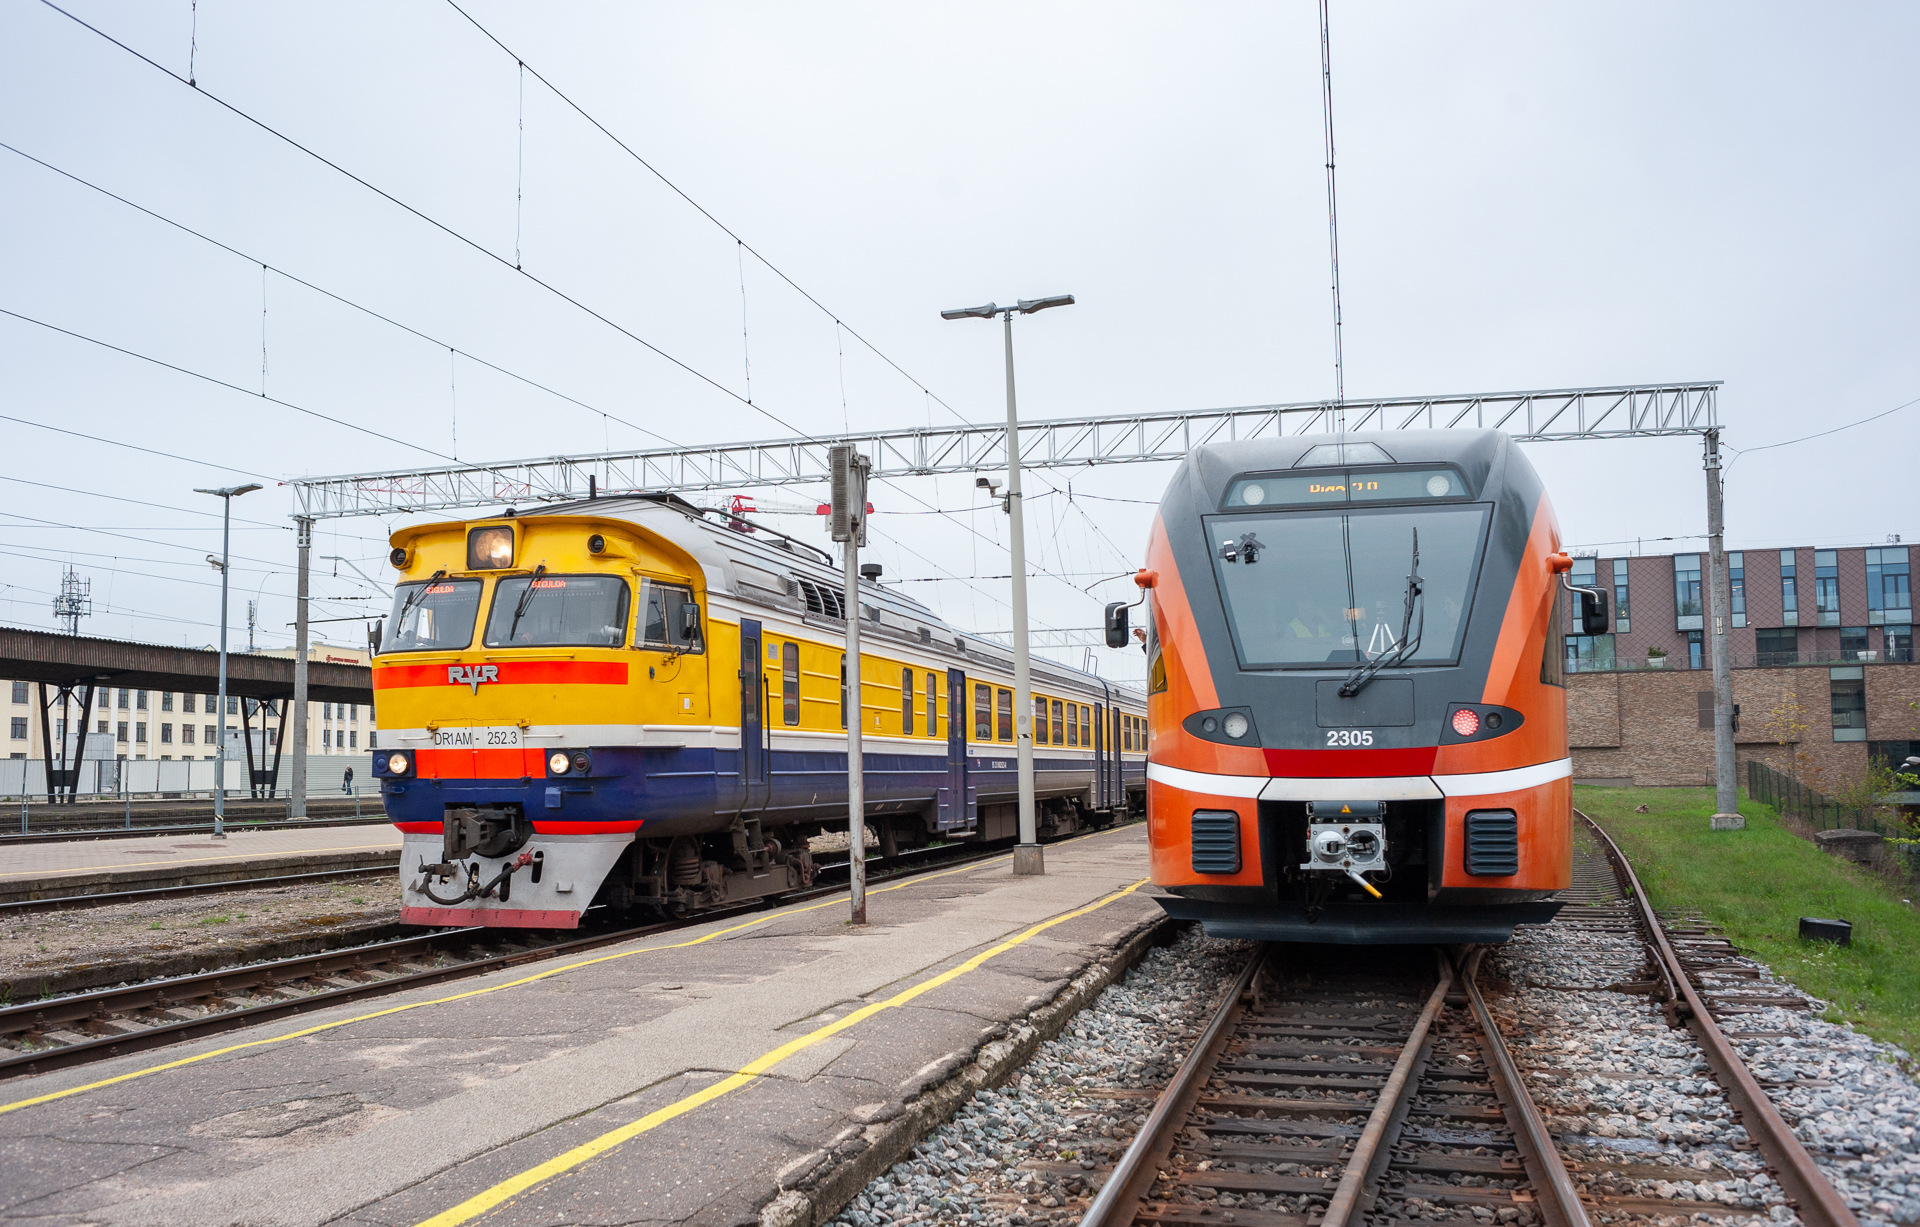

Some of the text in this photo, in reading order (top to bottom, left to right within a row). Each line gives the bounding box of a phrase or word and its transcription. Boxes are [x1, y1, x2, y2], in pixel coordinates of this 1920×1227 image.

[426, 586, 455, 594] SIGULDA
[532, 580, 567, 588] SIGULDA
[447, 665, 499, 695] RVR
[487, 731, 518, 745] 252.3
[1326, 730, 1374, 746] 2305
